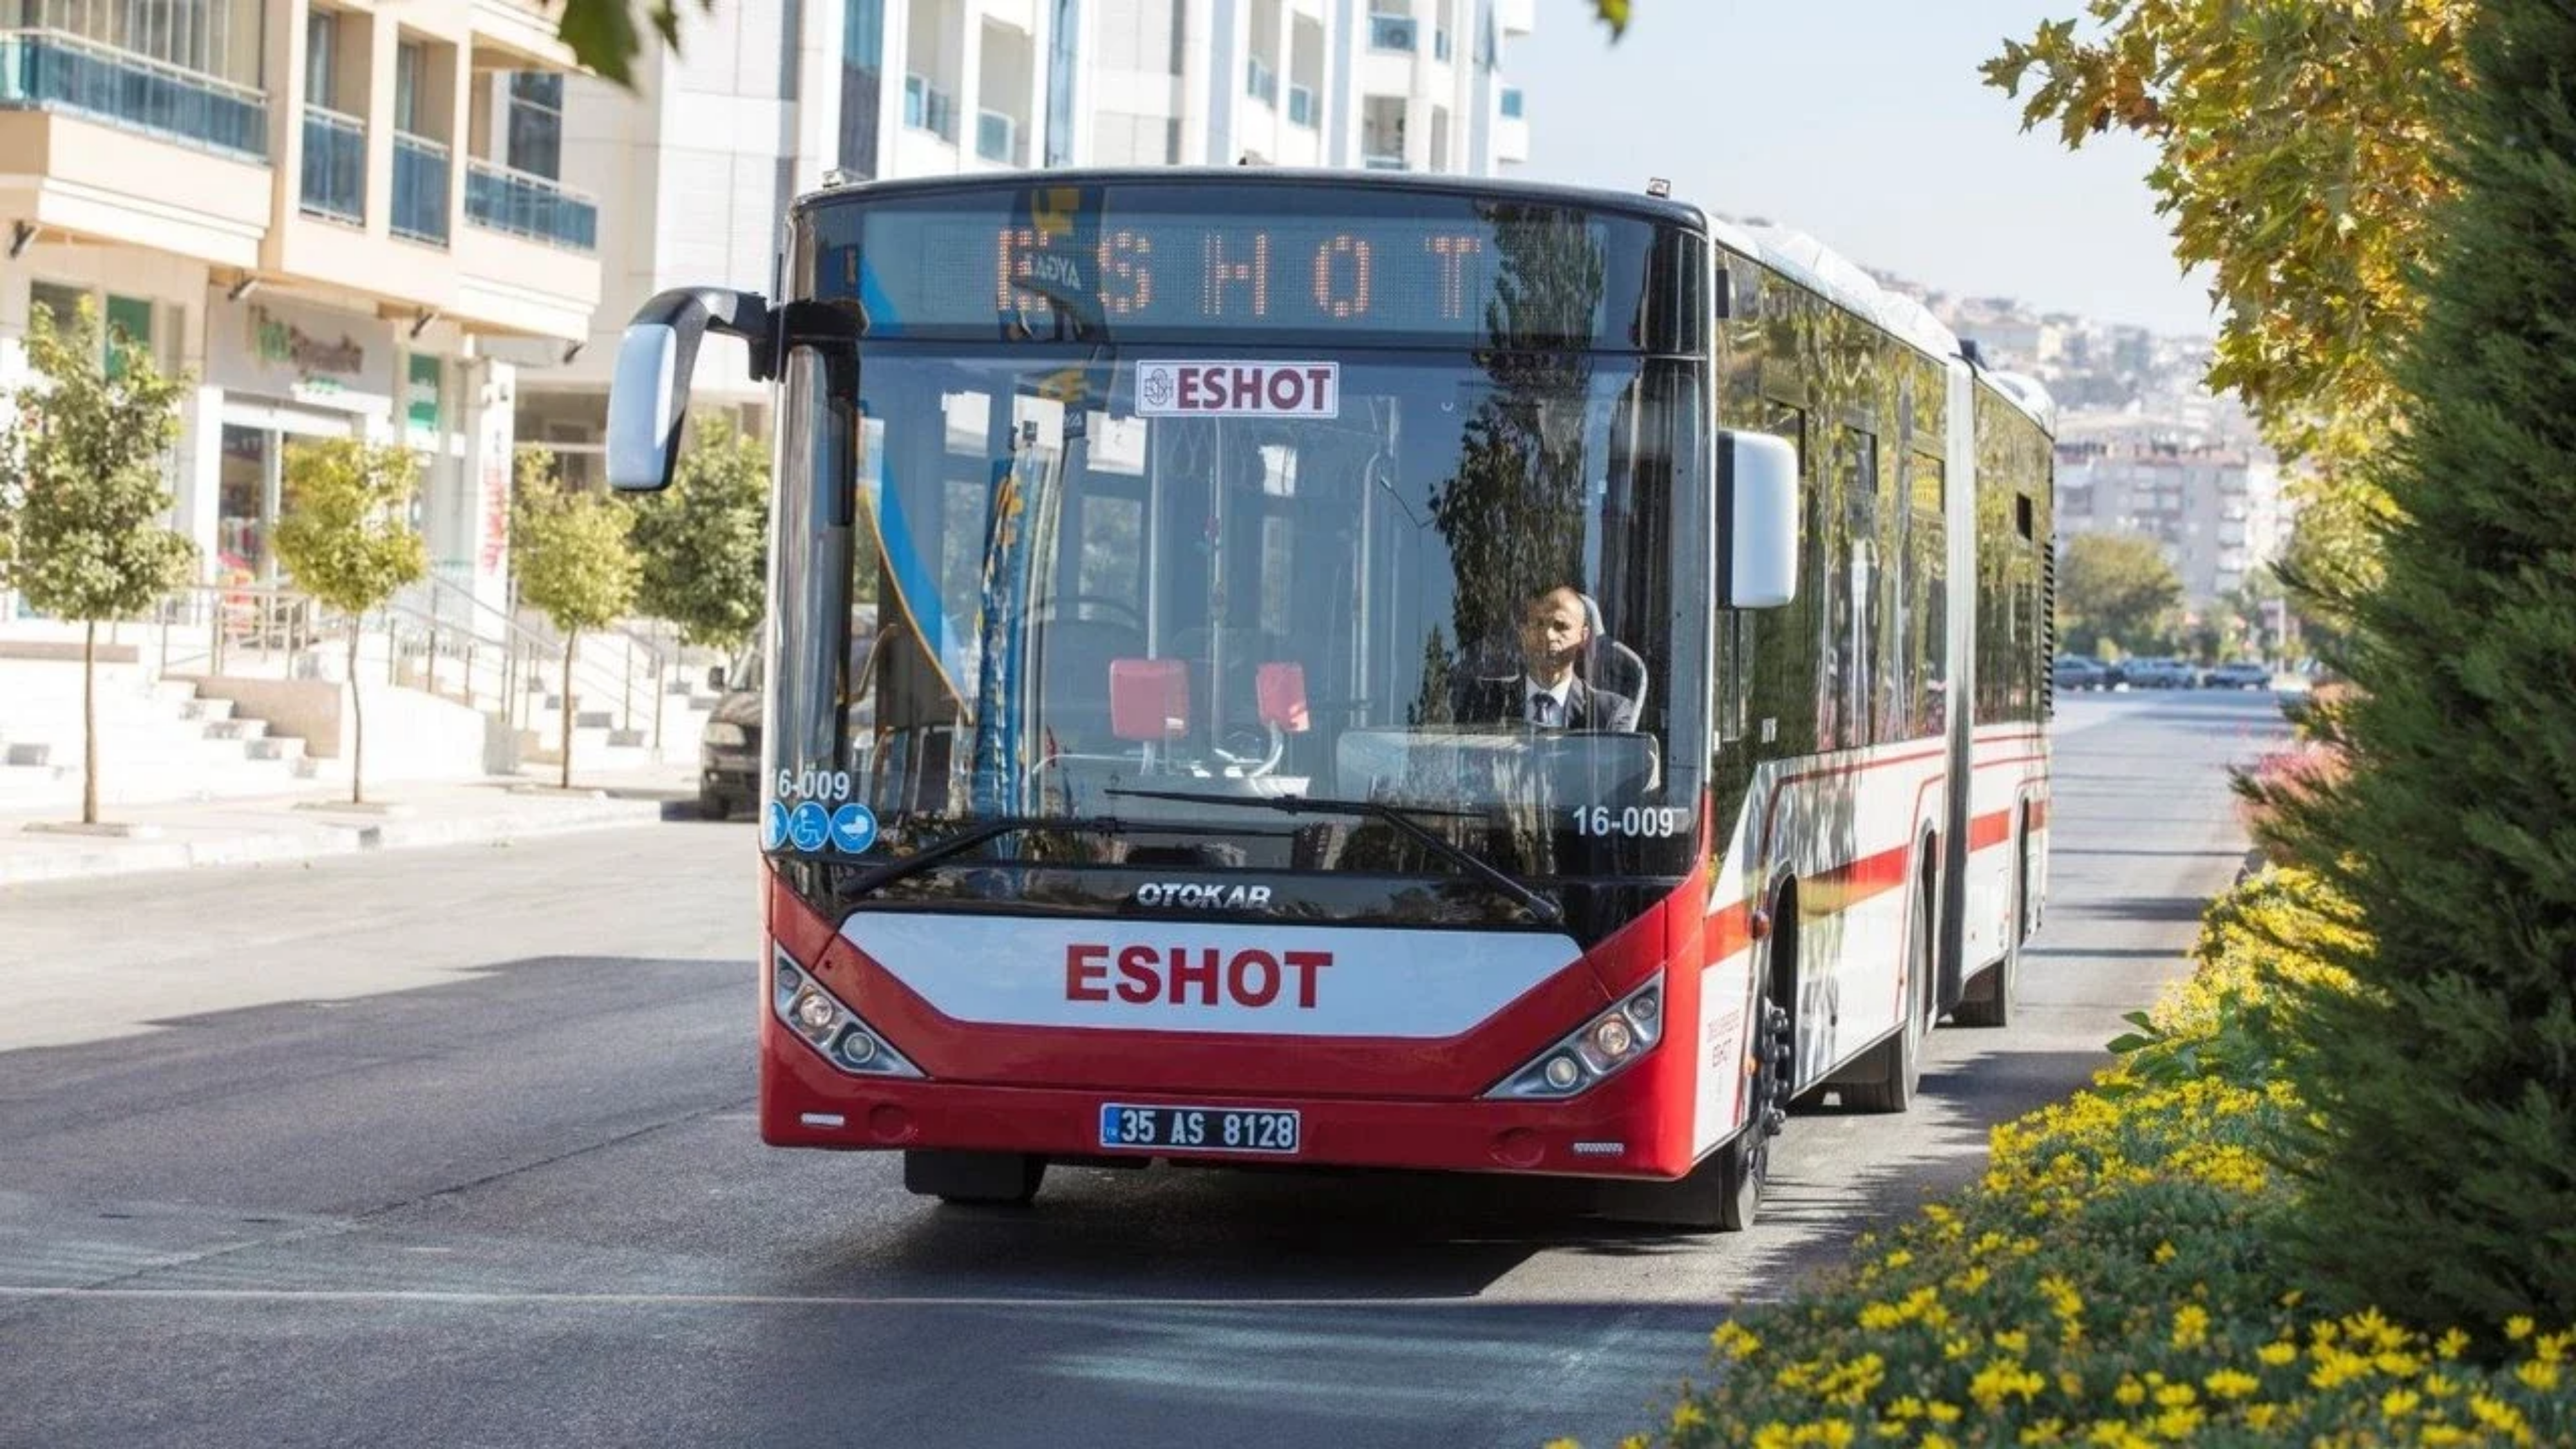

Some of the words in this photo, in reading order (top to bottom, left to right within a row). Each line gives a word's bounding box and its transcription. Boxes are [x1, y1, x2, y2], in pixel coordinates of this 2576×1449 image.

[997, 229, 1482, 319] ESHOT
[1177, 367, 1331, 410] ESHOT
[1573, 805, 1674, 838] 16-009
[1137, 882, 1271, 909] OTOKAR
[1066, 944, 1333, 1008] ESHOT
[1122, 1110, 1155, 1142] 35
[1170, 1112, 1205, 1144] AS
[1224, 1114, 1293, 1146] 8128
